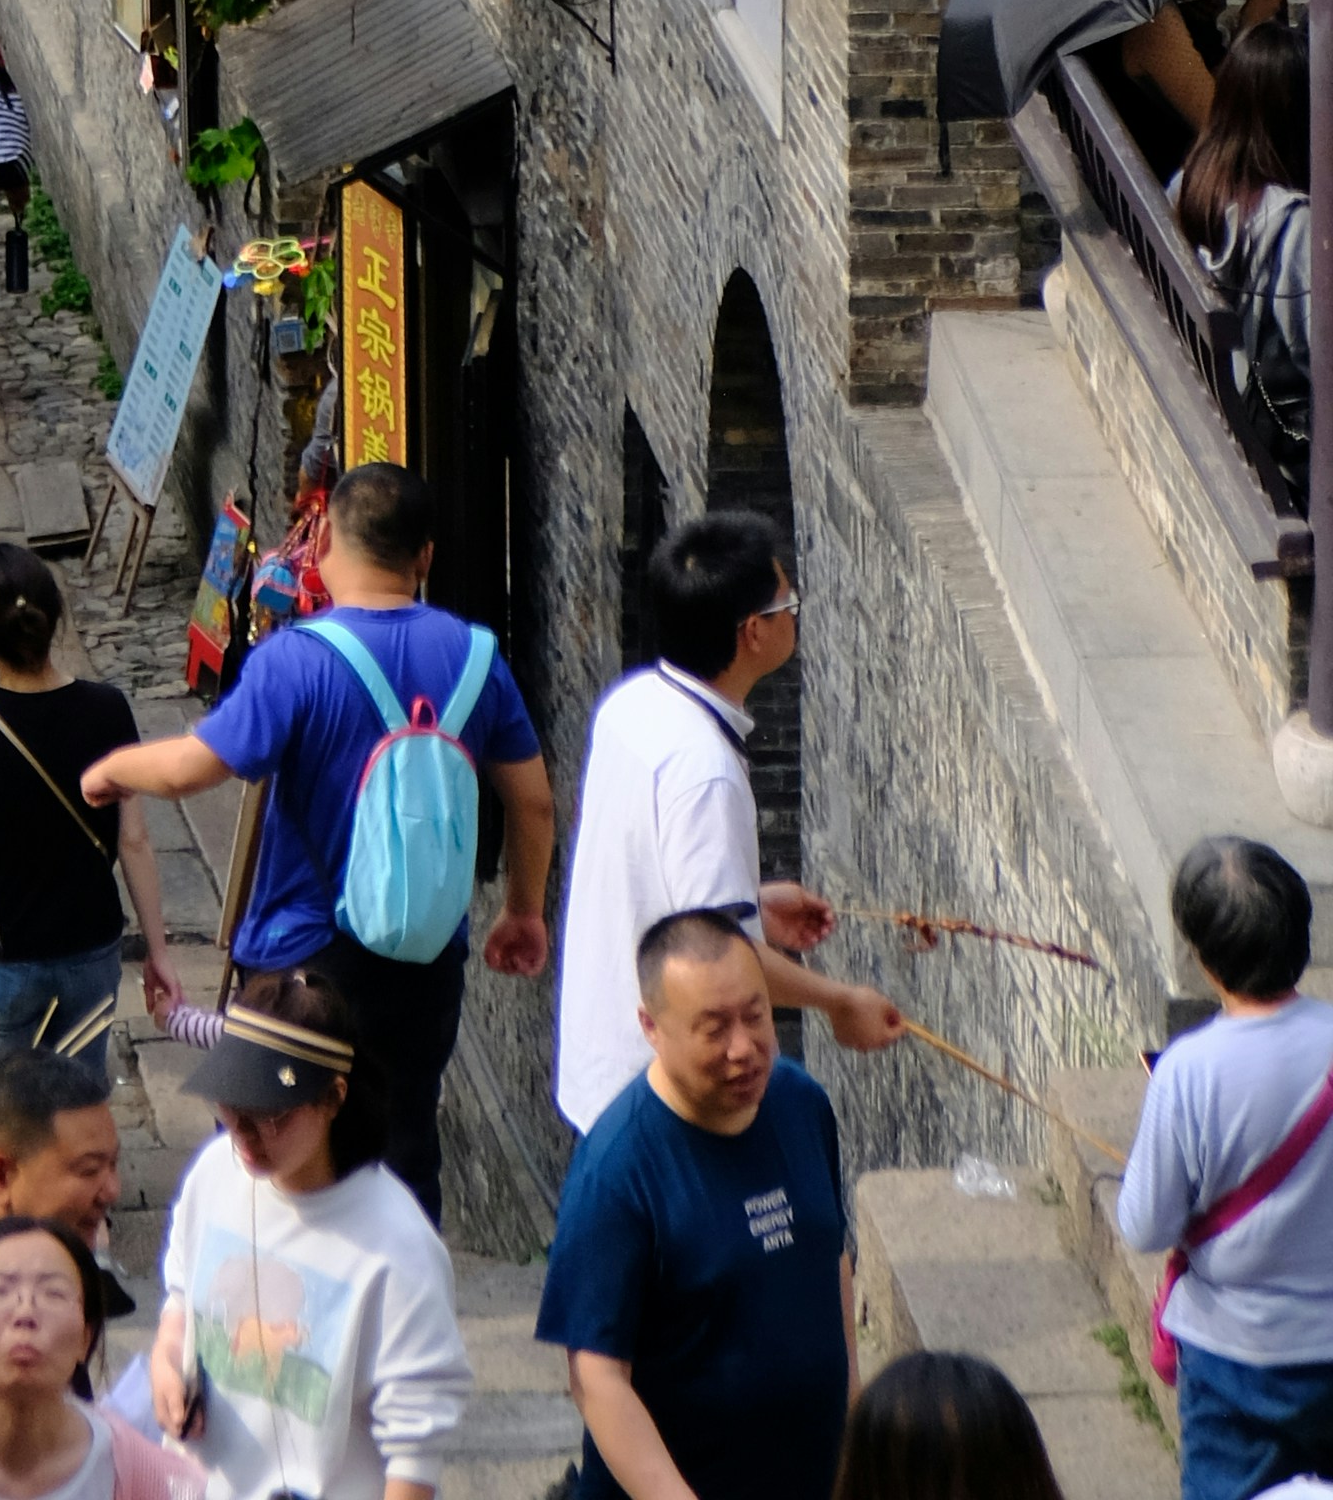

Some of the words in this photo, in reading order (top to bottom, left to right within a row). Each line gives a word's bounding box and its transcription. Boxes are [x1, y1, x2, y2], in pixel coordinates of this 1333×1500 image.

[744, 1187, 788, 1218] POWER
[749, 1205, 794, 1238] ENERGY
[763, 1229, 794, 1253] ANTA
